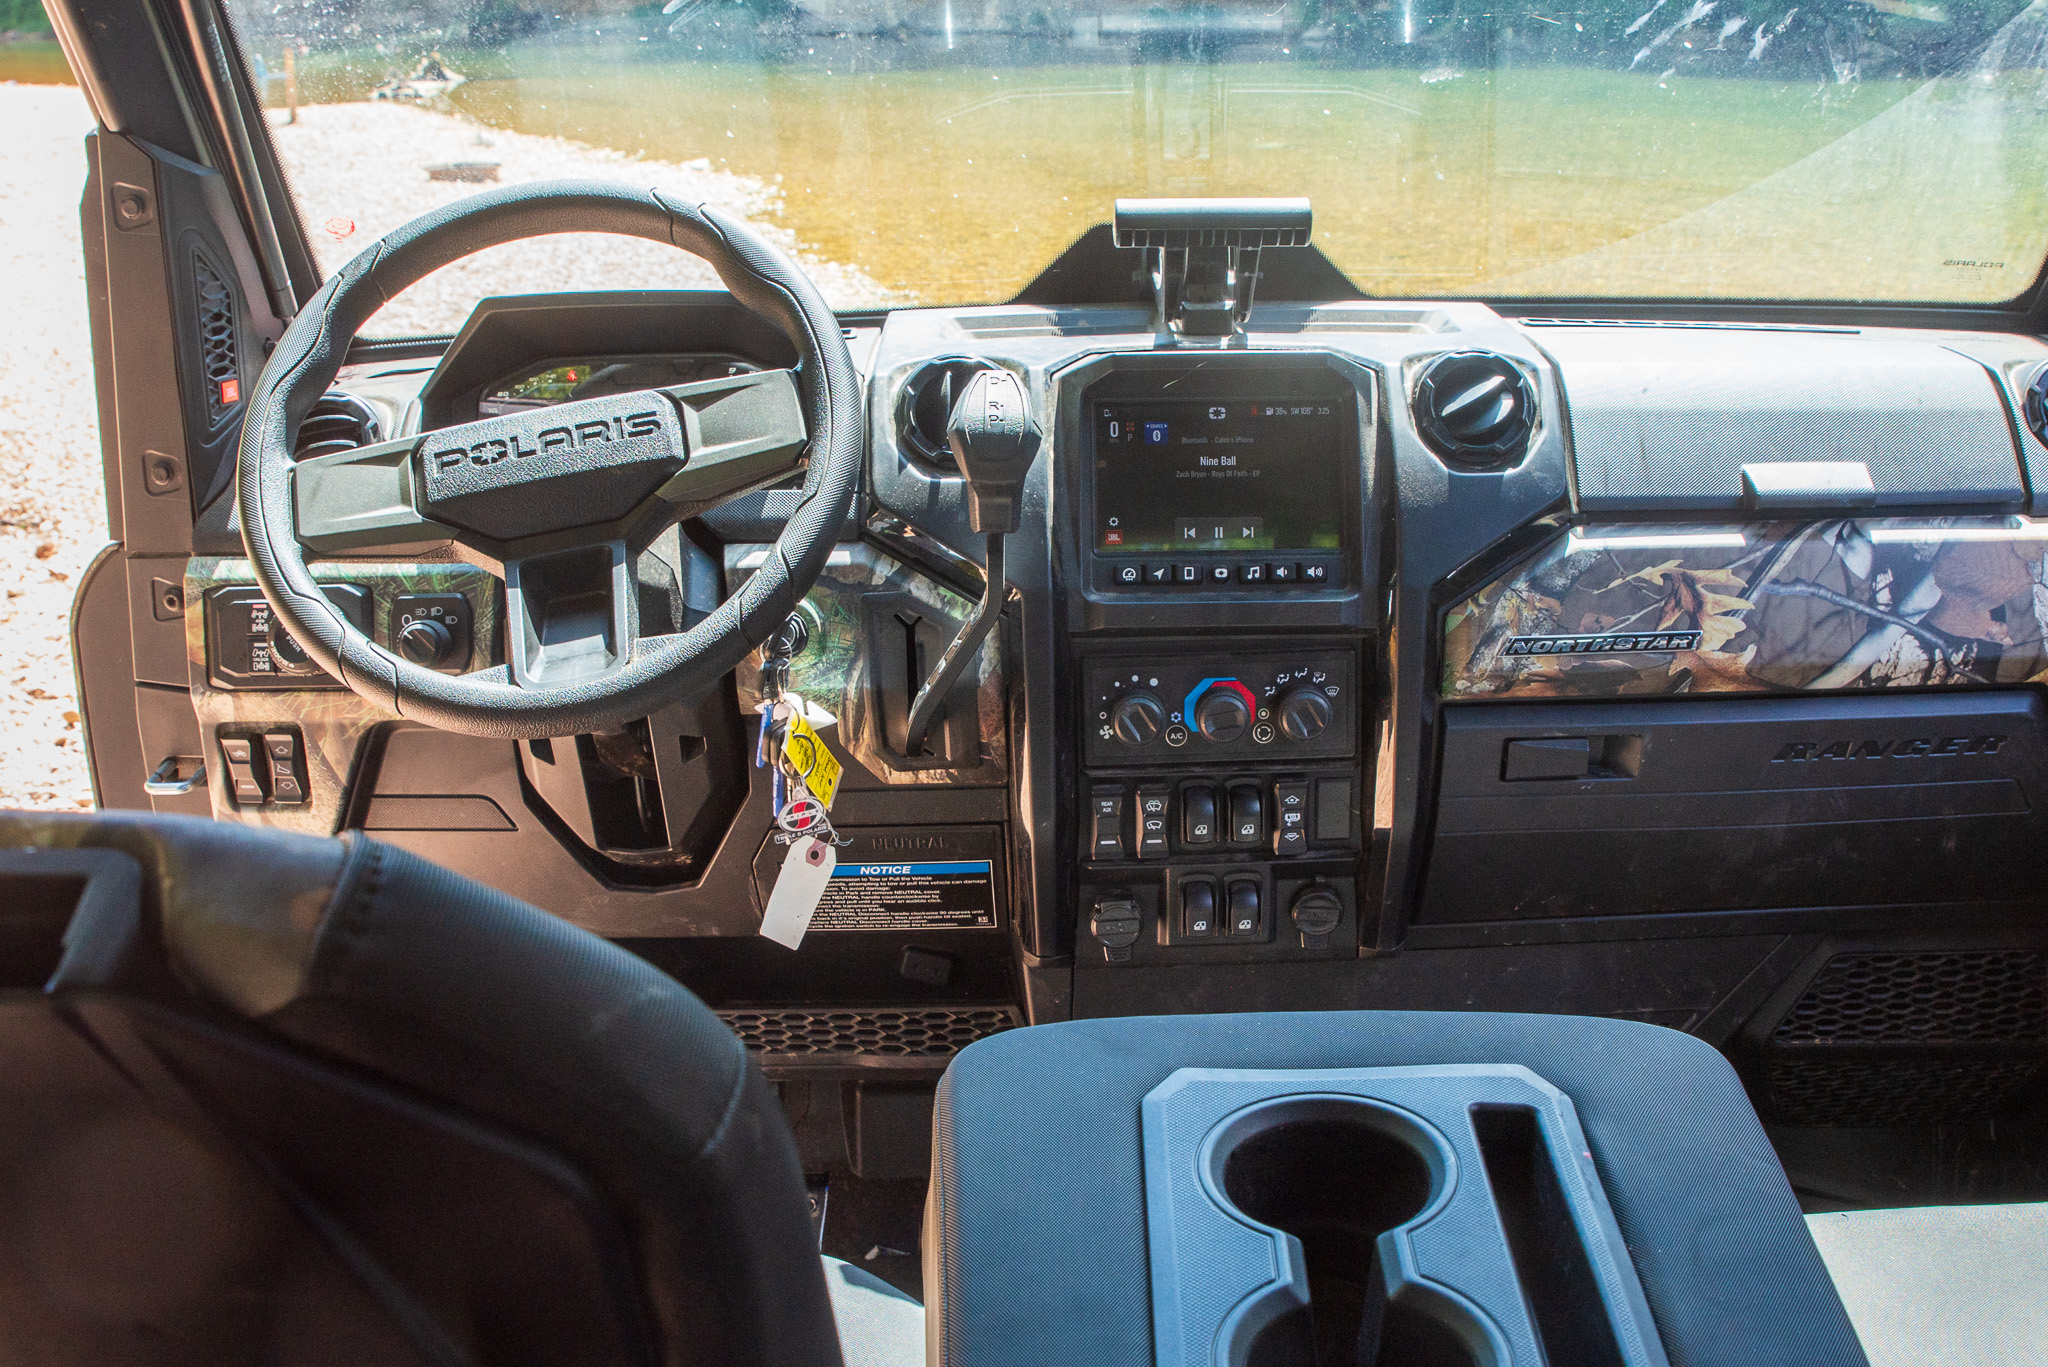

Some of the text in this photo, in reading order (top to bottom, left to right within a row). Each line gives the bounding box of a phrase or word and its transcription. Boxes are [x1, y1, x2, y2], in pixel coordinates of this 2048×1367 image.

[1110, 421, 1119, 438] 0
[433, 410, 661, 477] POLARIS
[1128, 433, 1133, 442] P
[1200, 455, 1237, 466] Nine Ball
[1191, 470, 1206, 479] Bryan
[1212, 470, 1225, 478] Boys
[286, 635, 302, 652] PUSH
[1509, 636, 1692, 654] NORTHSTAR
[1770, 735, 2009, 763] RANGER
[783, 808, 819, 820] TRIPLE
[802, 826, 828, 835] POLARIS
[872, 837, 949, 849] NEUTRAL
[860, 866, 911, 874] NOTICE
